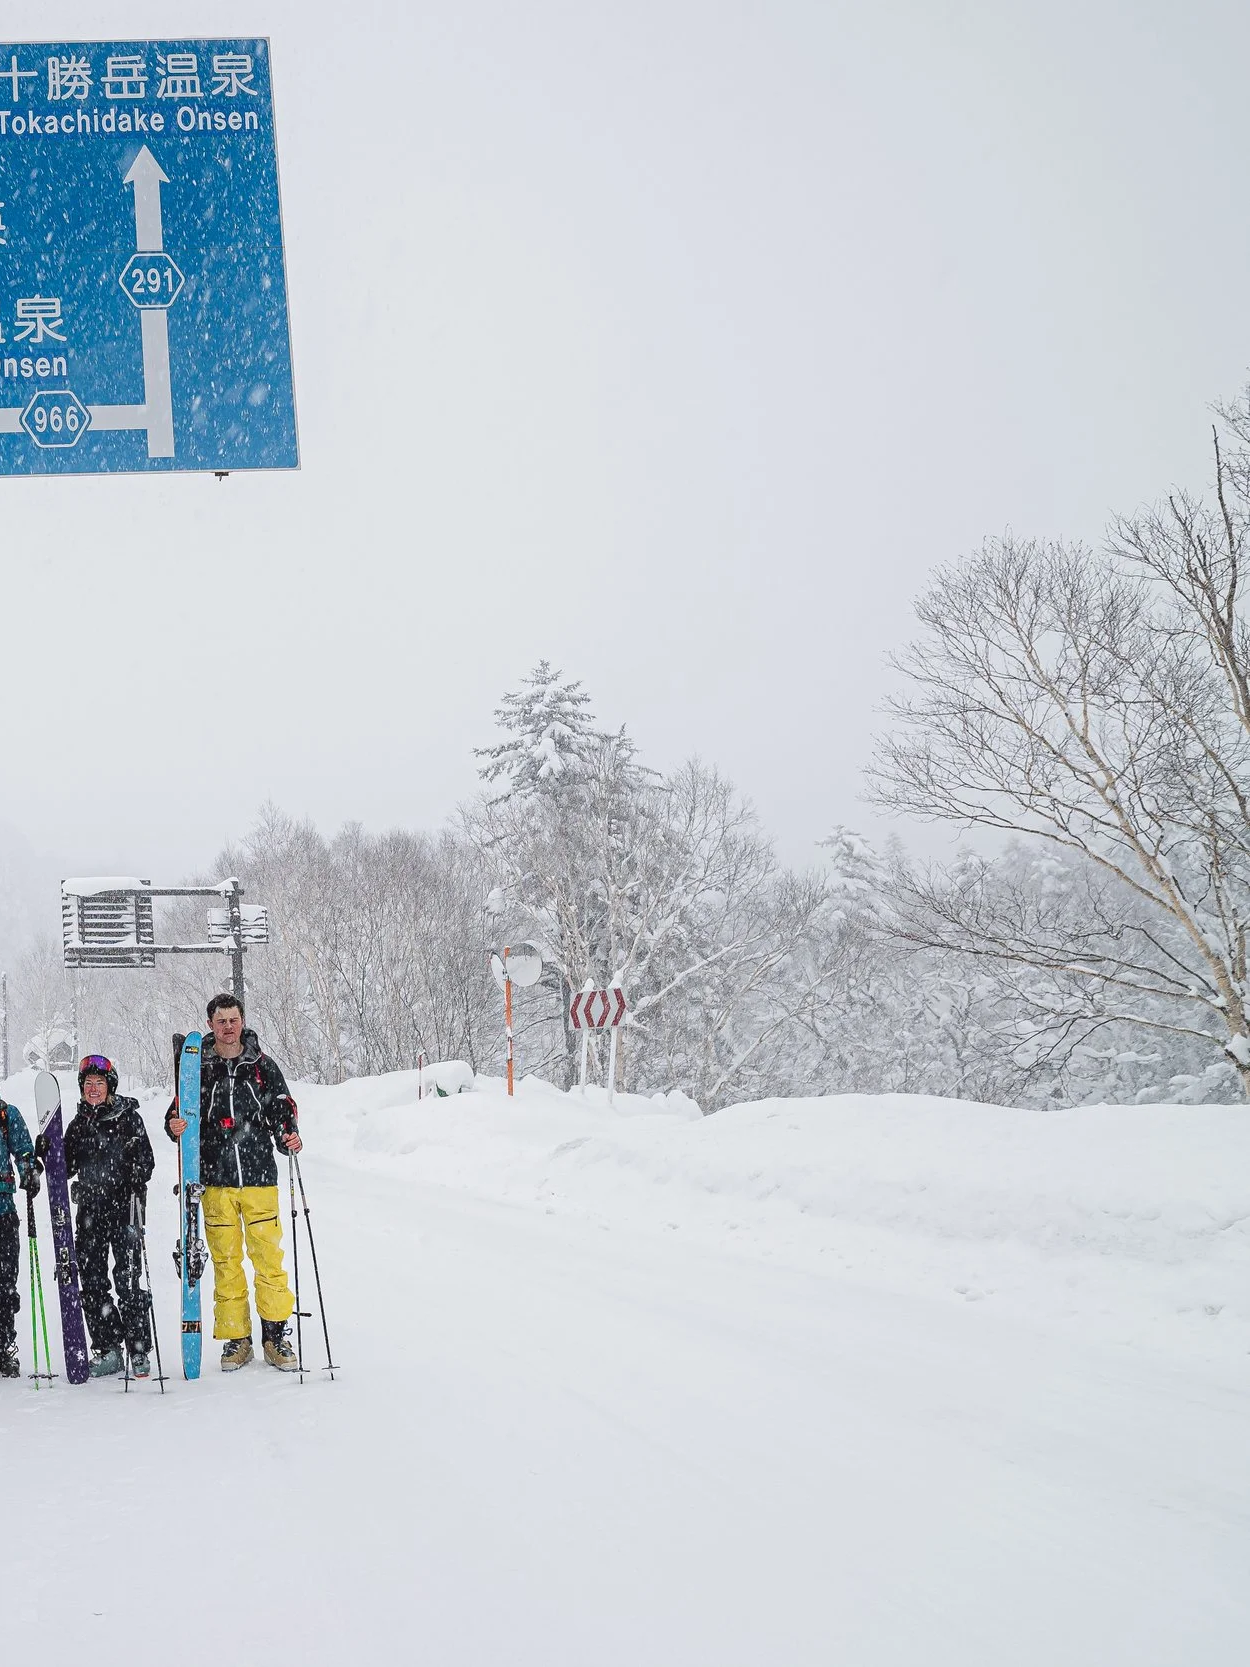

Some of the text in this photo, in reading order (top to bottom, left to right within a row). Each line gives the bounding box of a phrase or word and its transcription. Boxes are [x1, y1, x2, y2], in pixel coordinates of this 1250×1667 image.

[177, 106, 259, 131] Onsen
[131, 268, 174, 293] 291
[33, 405, 79, 432] 966
